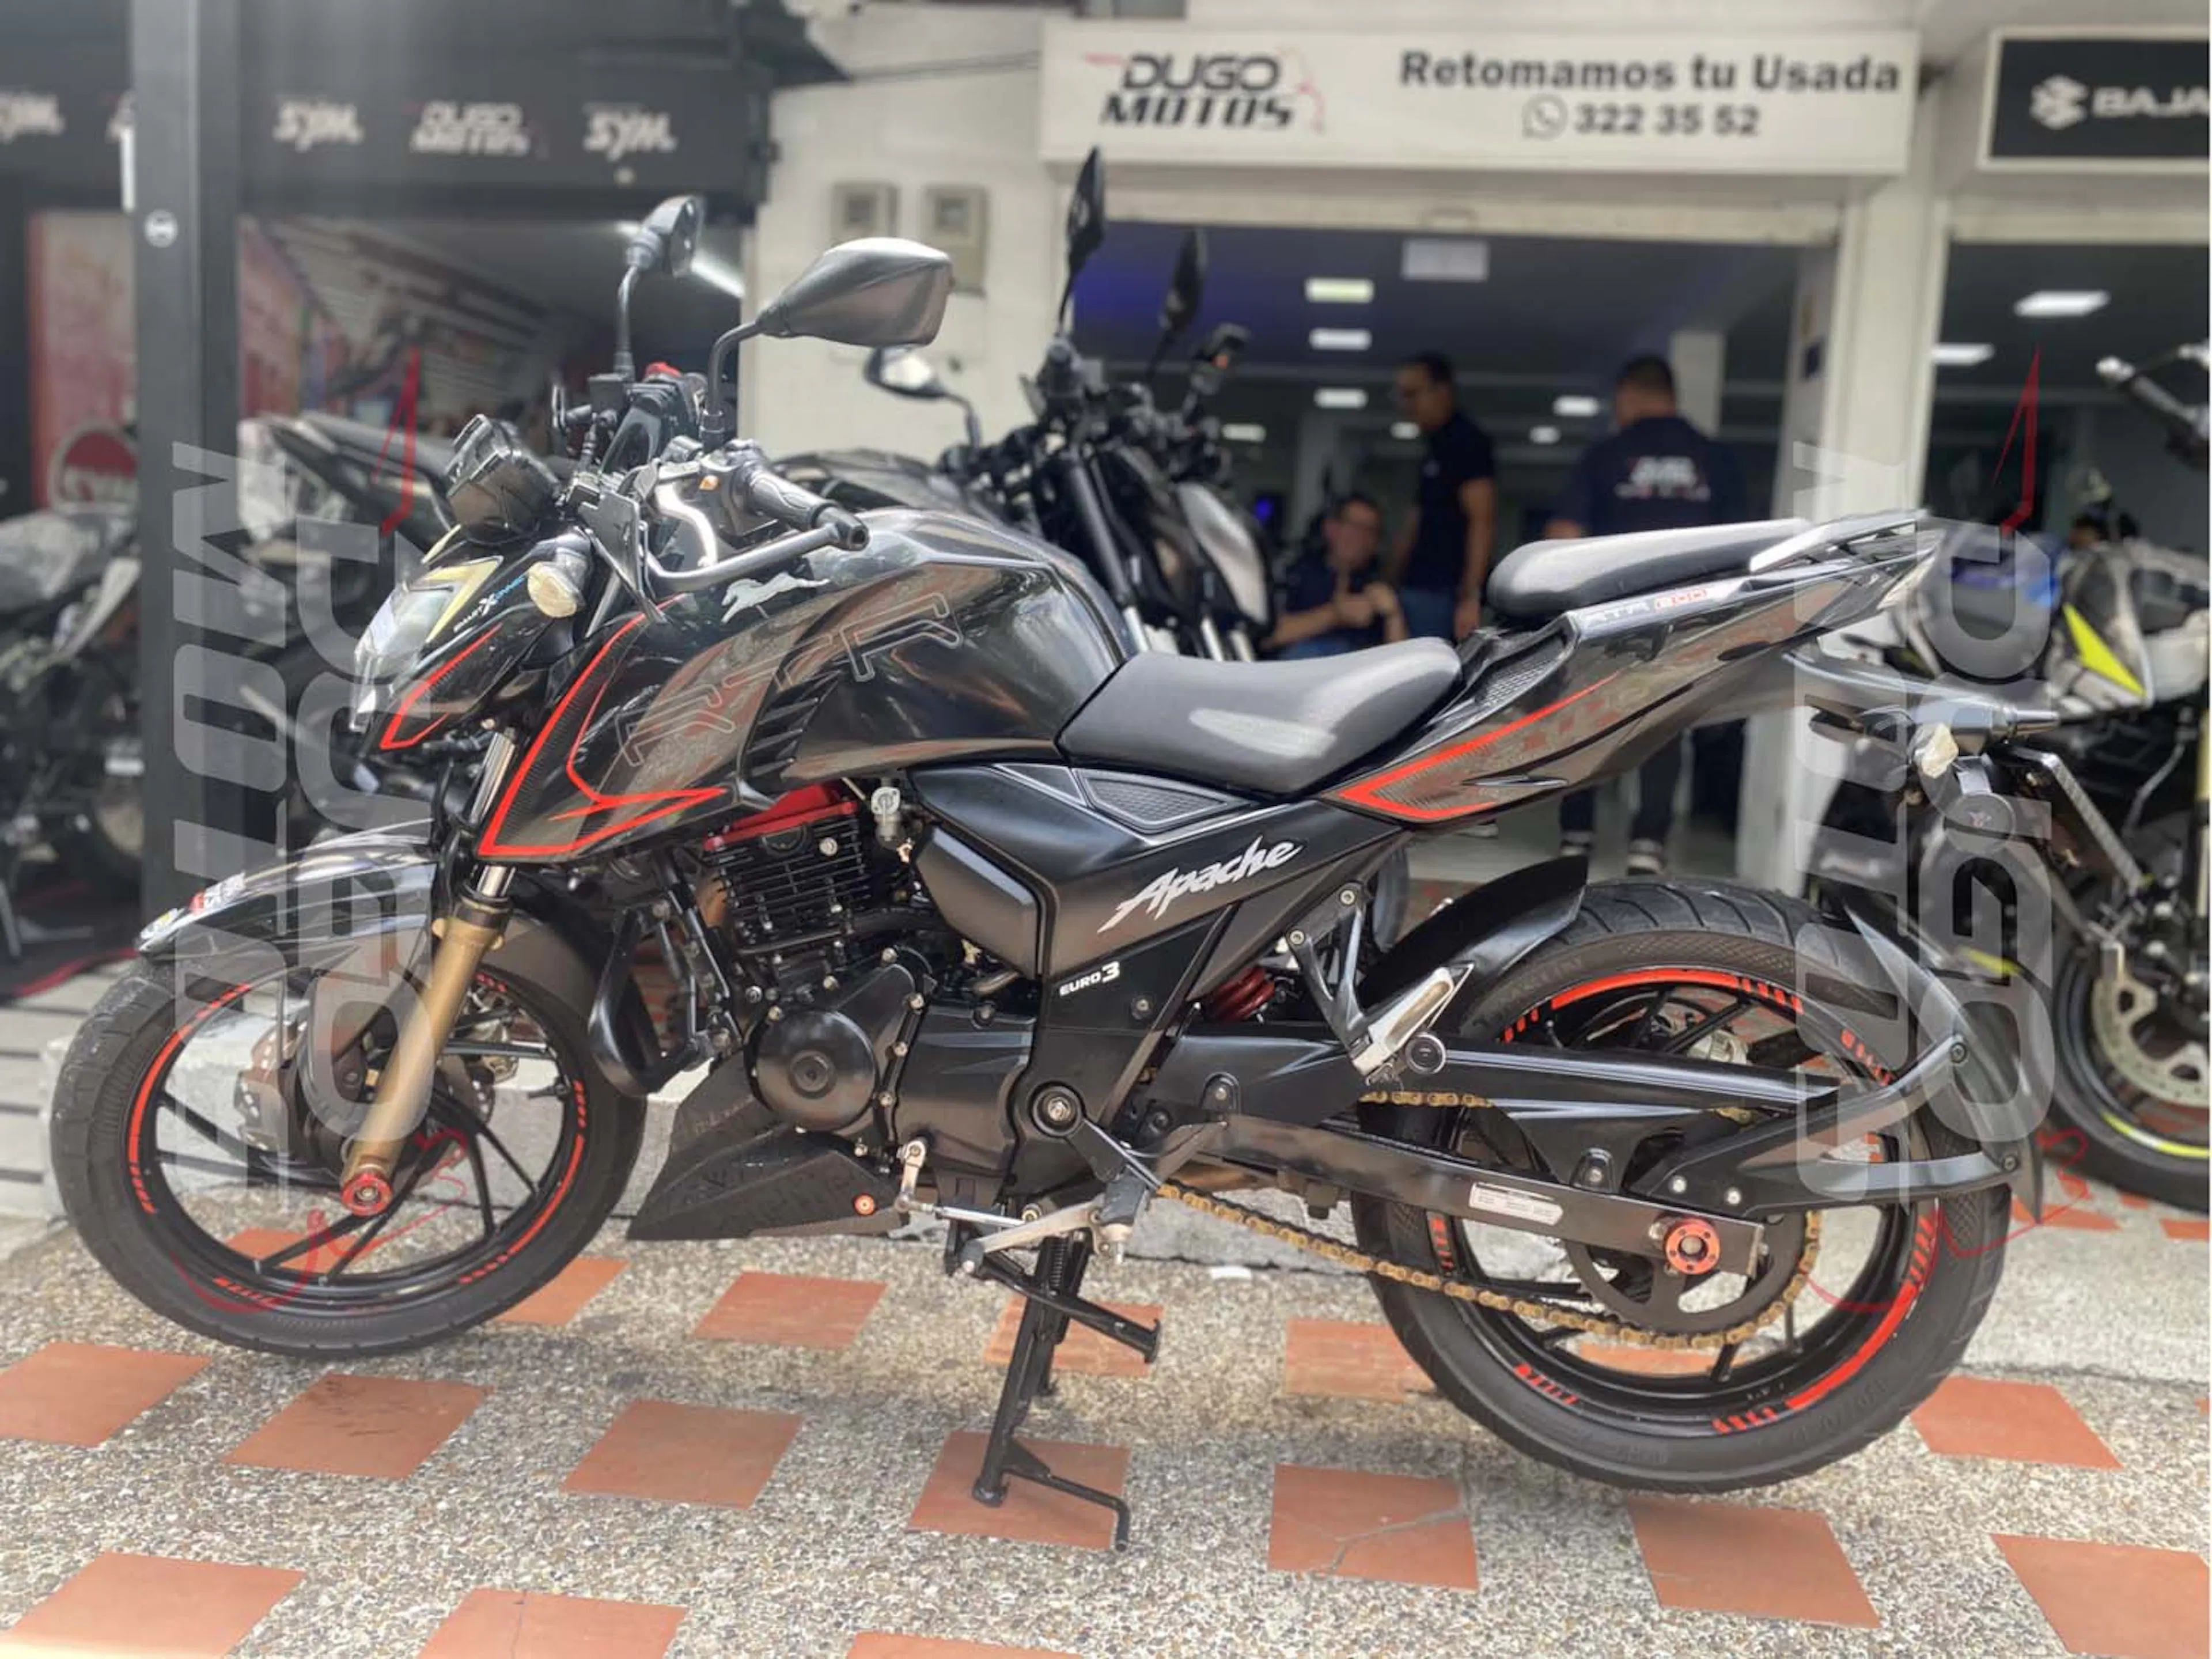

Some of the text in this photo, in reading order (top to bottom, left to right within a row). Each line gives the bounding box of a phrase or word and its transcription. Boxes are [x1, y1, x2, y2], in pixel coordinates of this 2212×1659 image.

[1122, 54, 1282, 91] DUGO
[1400, 52, 1901, 93] Retomamos tu Usada
[1099, 92, 1295, 129] MOTOS
[1573, 104, 1760, 137] 322 35 52
[1097, 835, 1303, 934] Apache
